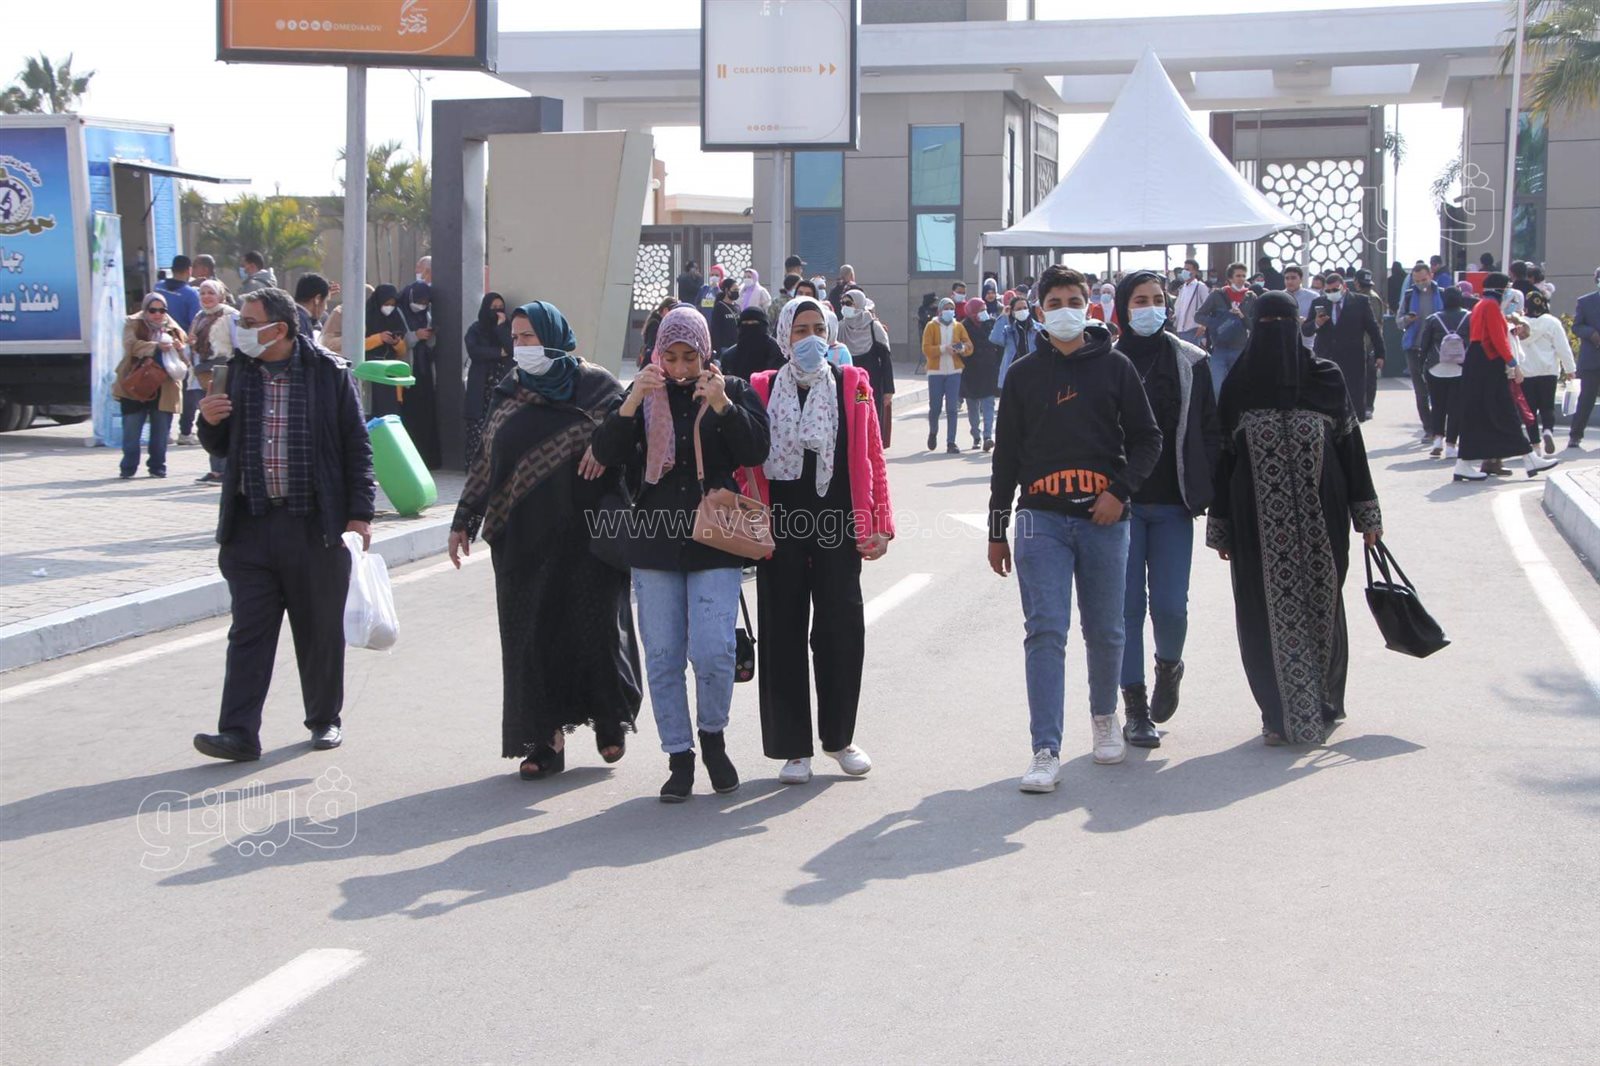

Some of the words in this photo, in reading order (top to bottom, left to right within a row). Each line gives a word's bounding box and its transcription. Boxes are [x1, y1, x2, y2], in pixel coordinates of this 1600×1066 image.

[733, 65, 776, 74] CREATING
[777, 64, 813, 74] STORIES
[18, 283, 60, 312] منفذ
